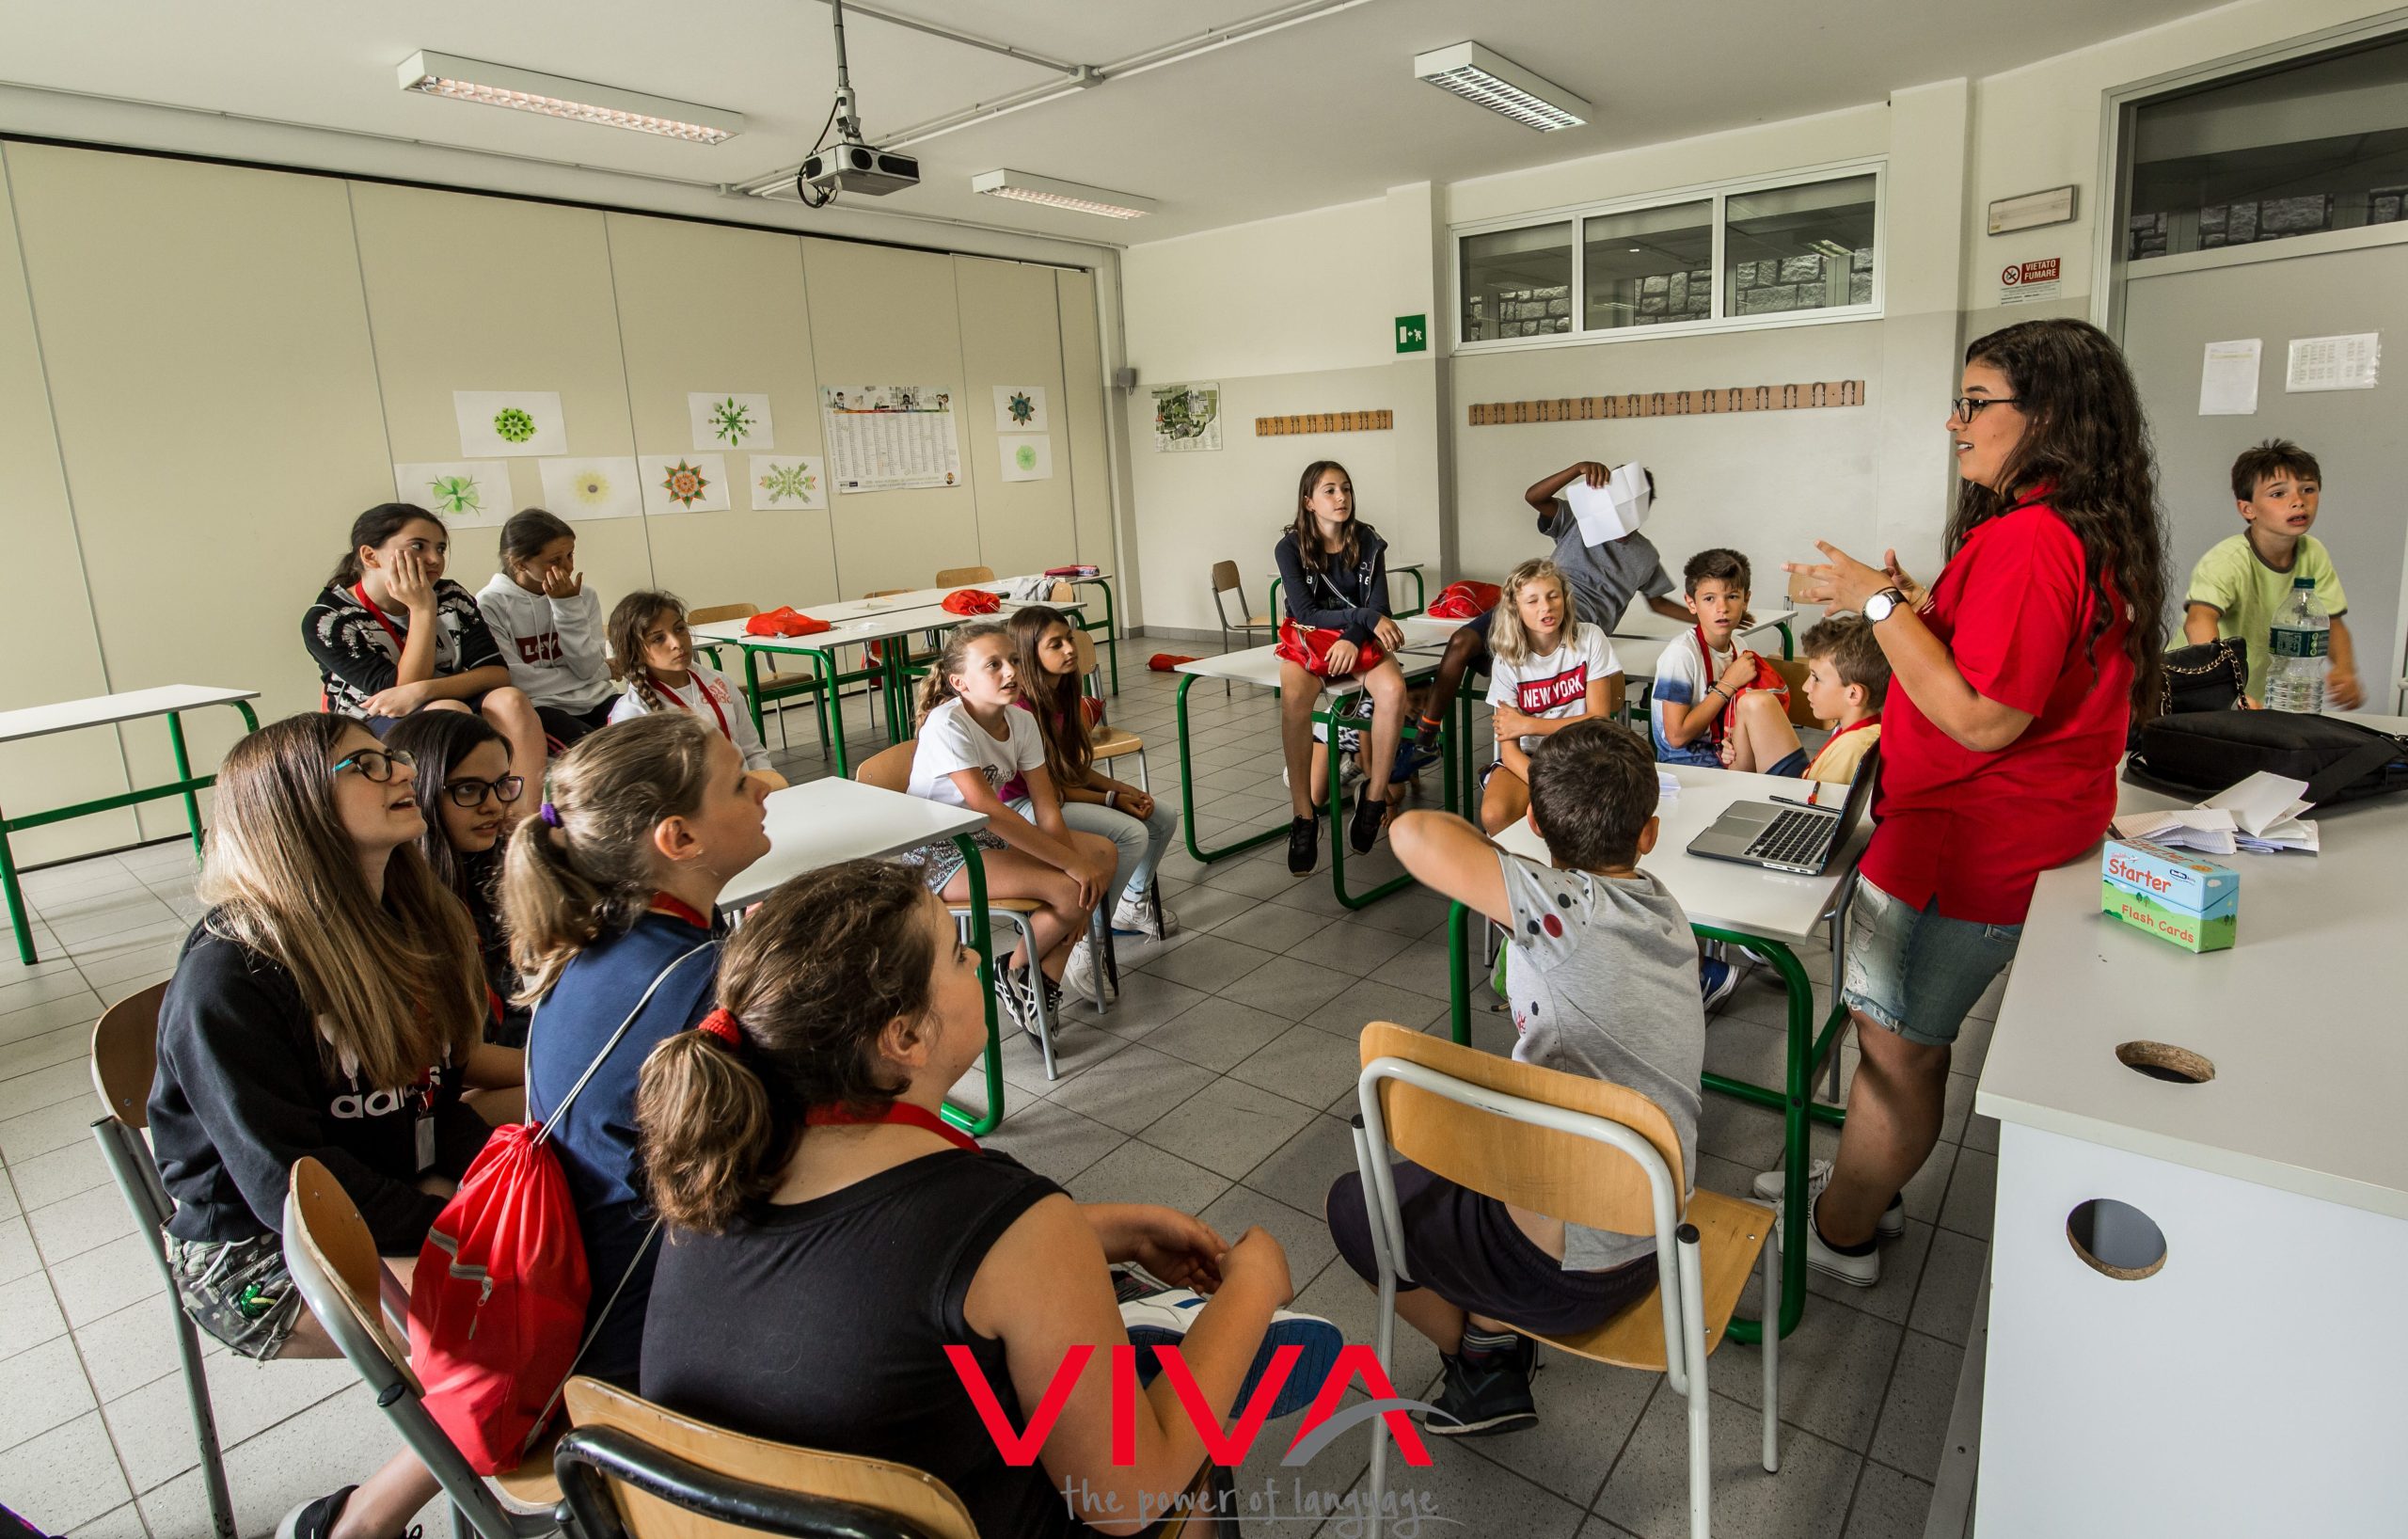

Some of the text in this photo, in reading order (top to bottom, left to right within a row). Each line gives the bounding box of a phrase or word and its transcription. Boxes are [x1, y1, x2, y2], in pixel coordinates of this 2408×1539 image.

[2024, 268, 2057, 280] FUMARE
[2025, 259, 2056, 272] VIETATO
[1523, 673, 1585, 708] NEW YORK
[2108, 858, 2172, 893] Starter
[2122, 904, 2194, 944] Flash Cards
[330, 1065, 441, 1119] adis
